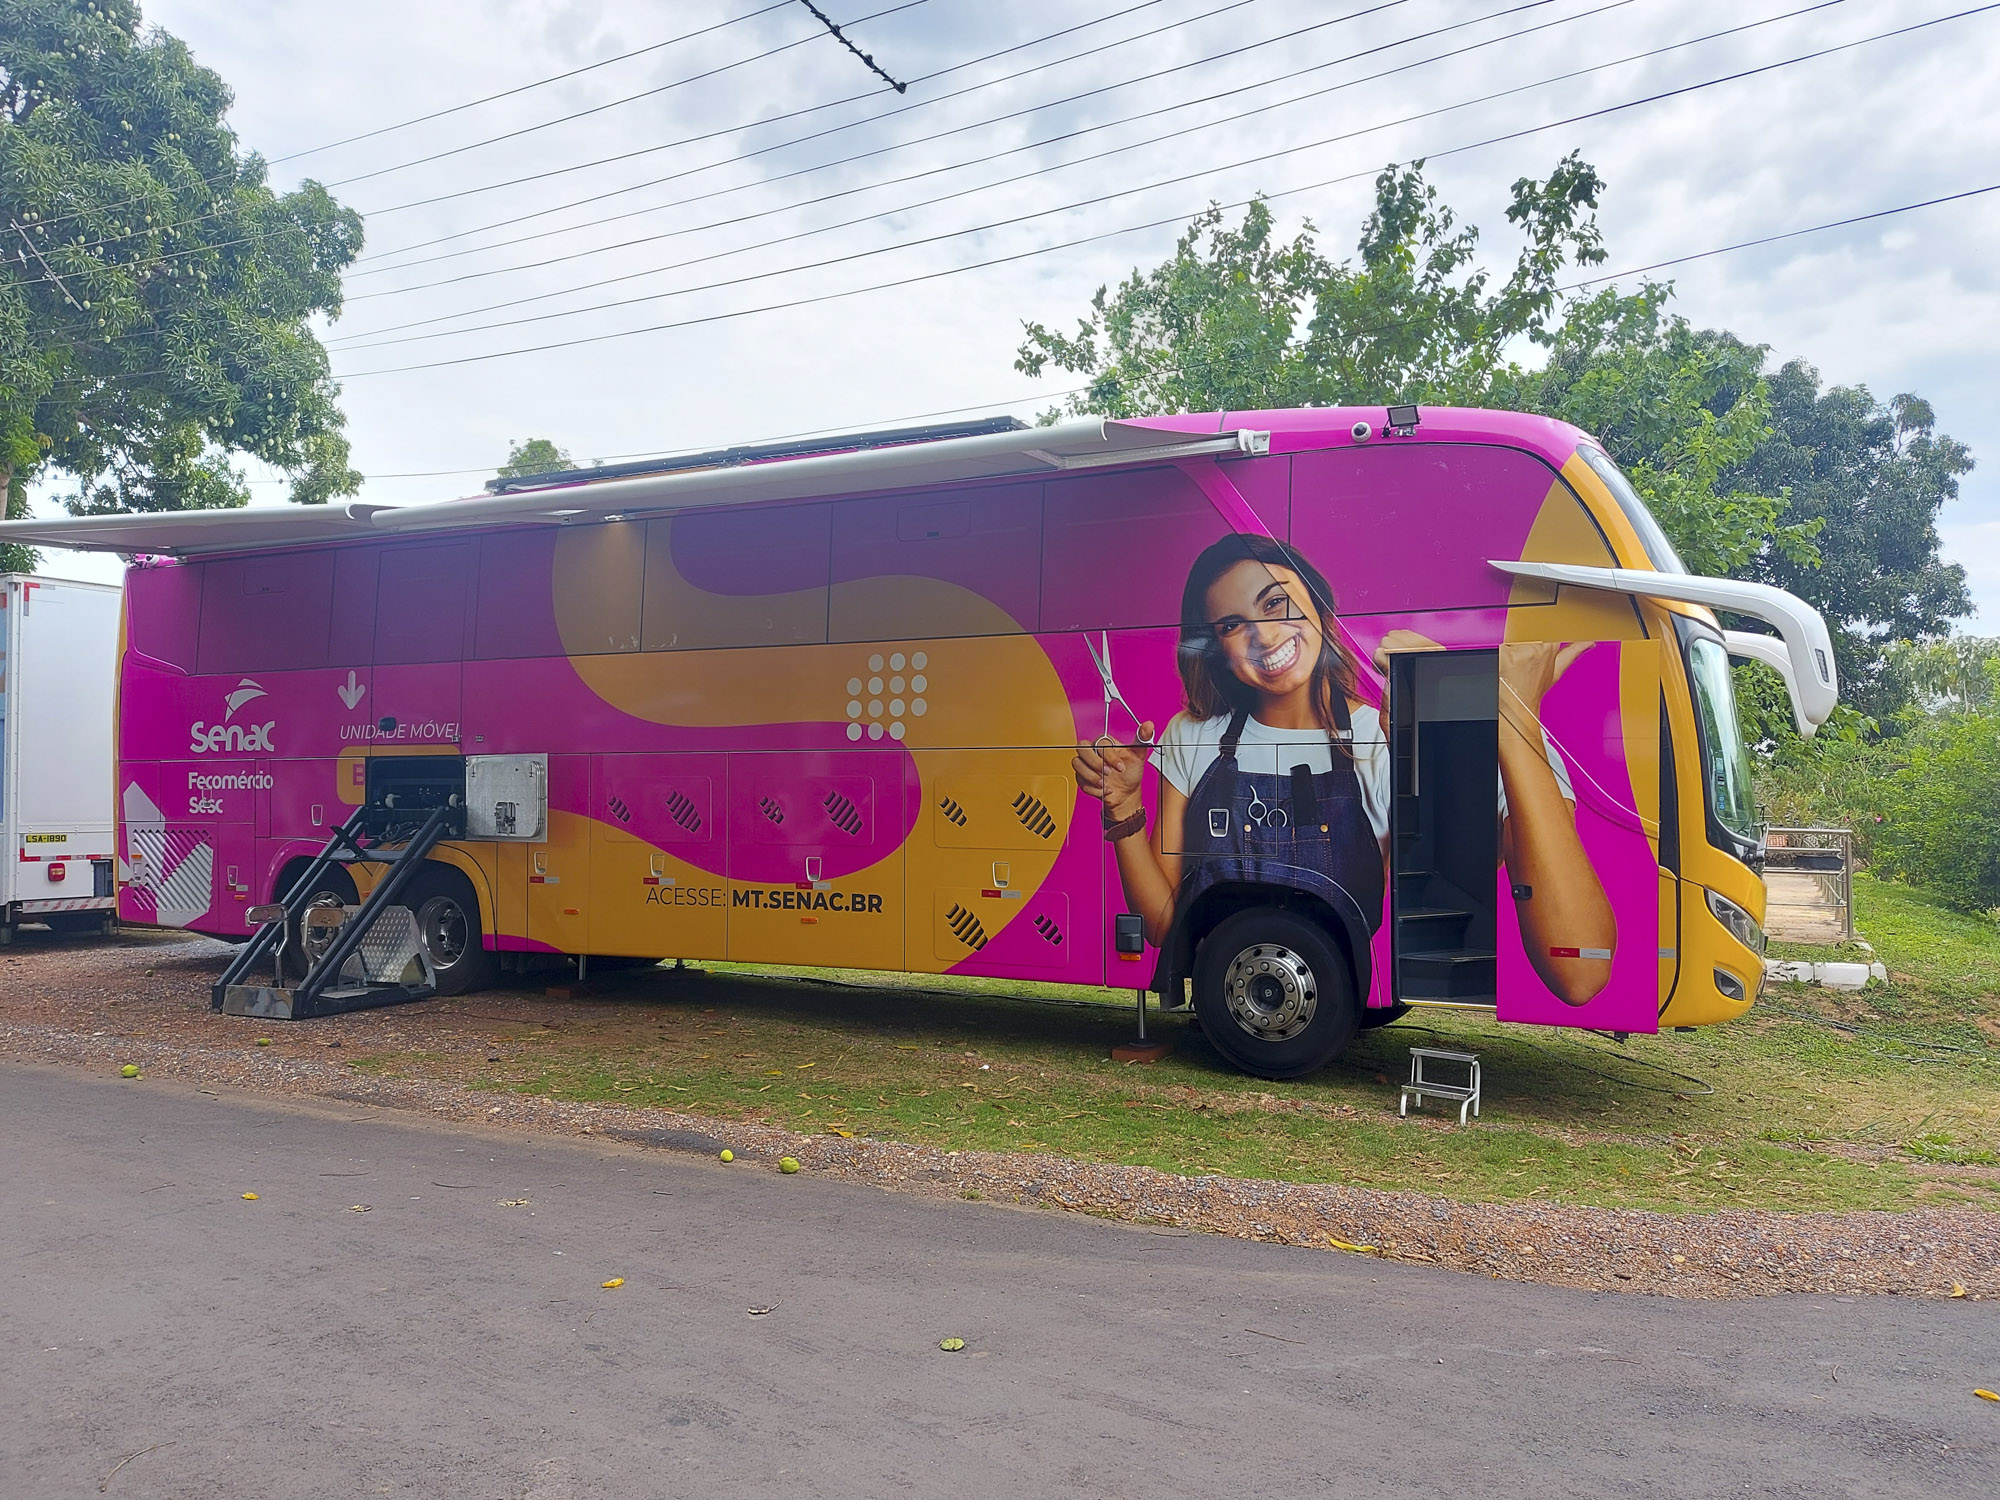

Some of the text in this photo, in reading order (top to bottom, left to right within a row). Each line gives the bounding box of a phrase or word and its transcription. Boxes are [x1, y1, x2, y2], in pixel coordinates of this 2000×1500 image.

[340, 724, 407, 740] UNIDADE
[188, 769, 274, 790] Fecomércio
[188, 796, 224, 814] Sesc
[26, 835, 66, 843] LSA-1890
[645, 887, 883, 914] ACESSE: MT.SENAC.BR
